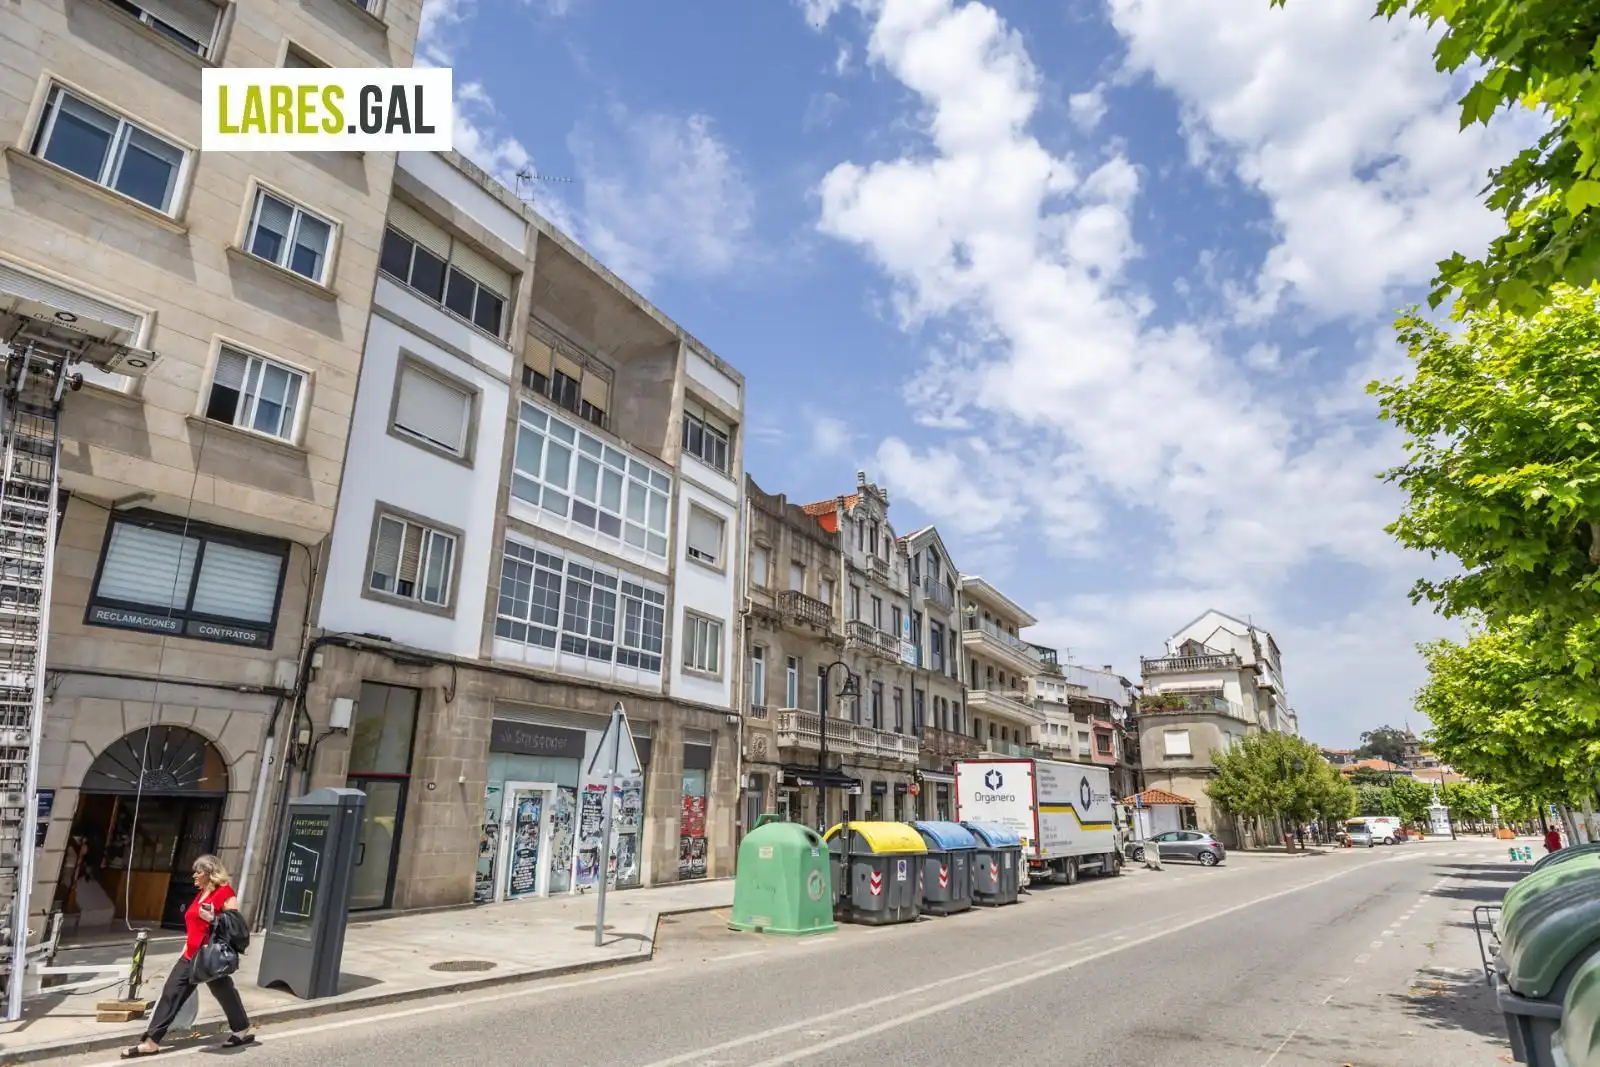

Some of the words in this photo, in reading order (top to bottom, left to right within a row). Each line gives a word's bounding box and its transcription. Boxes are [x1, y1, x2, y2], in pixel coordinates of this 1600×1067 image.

[96, 610, 176, 630] RECLAMACIONES
[199, 625, 256, 641] CONTRATOS
[974, 791, 1015, 804] Organero
